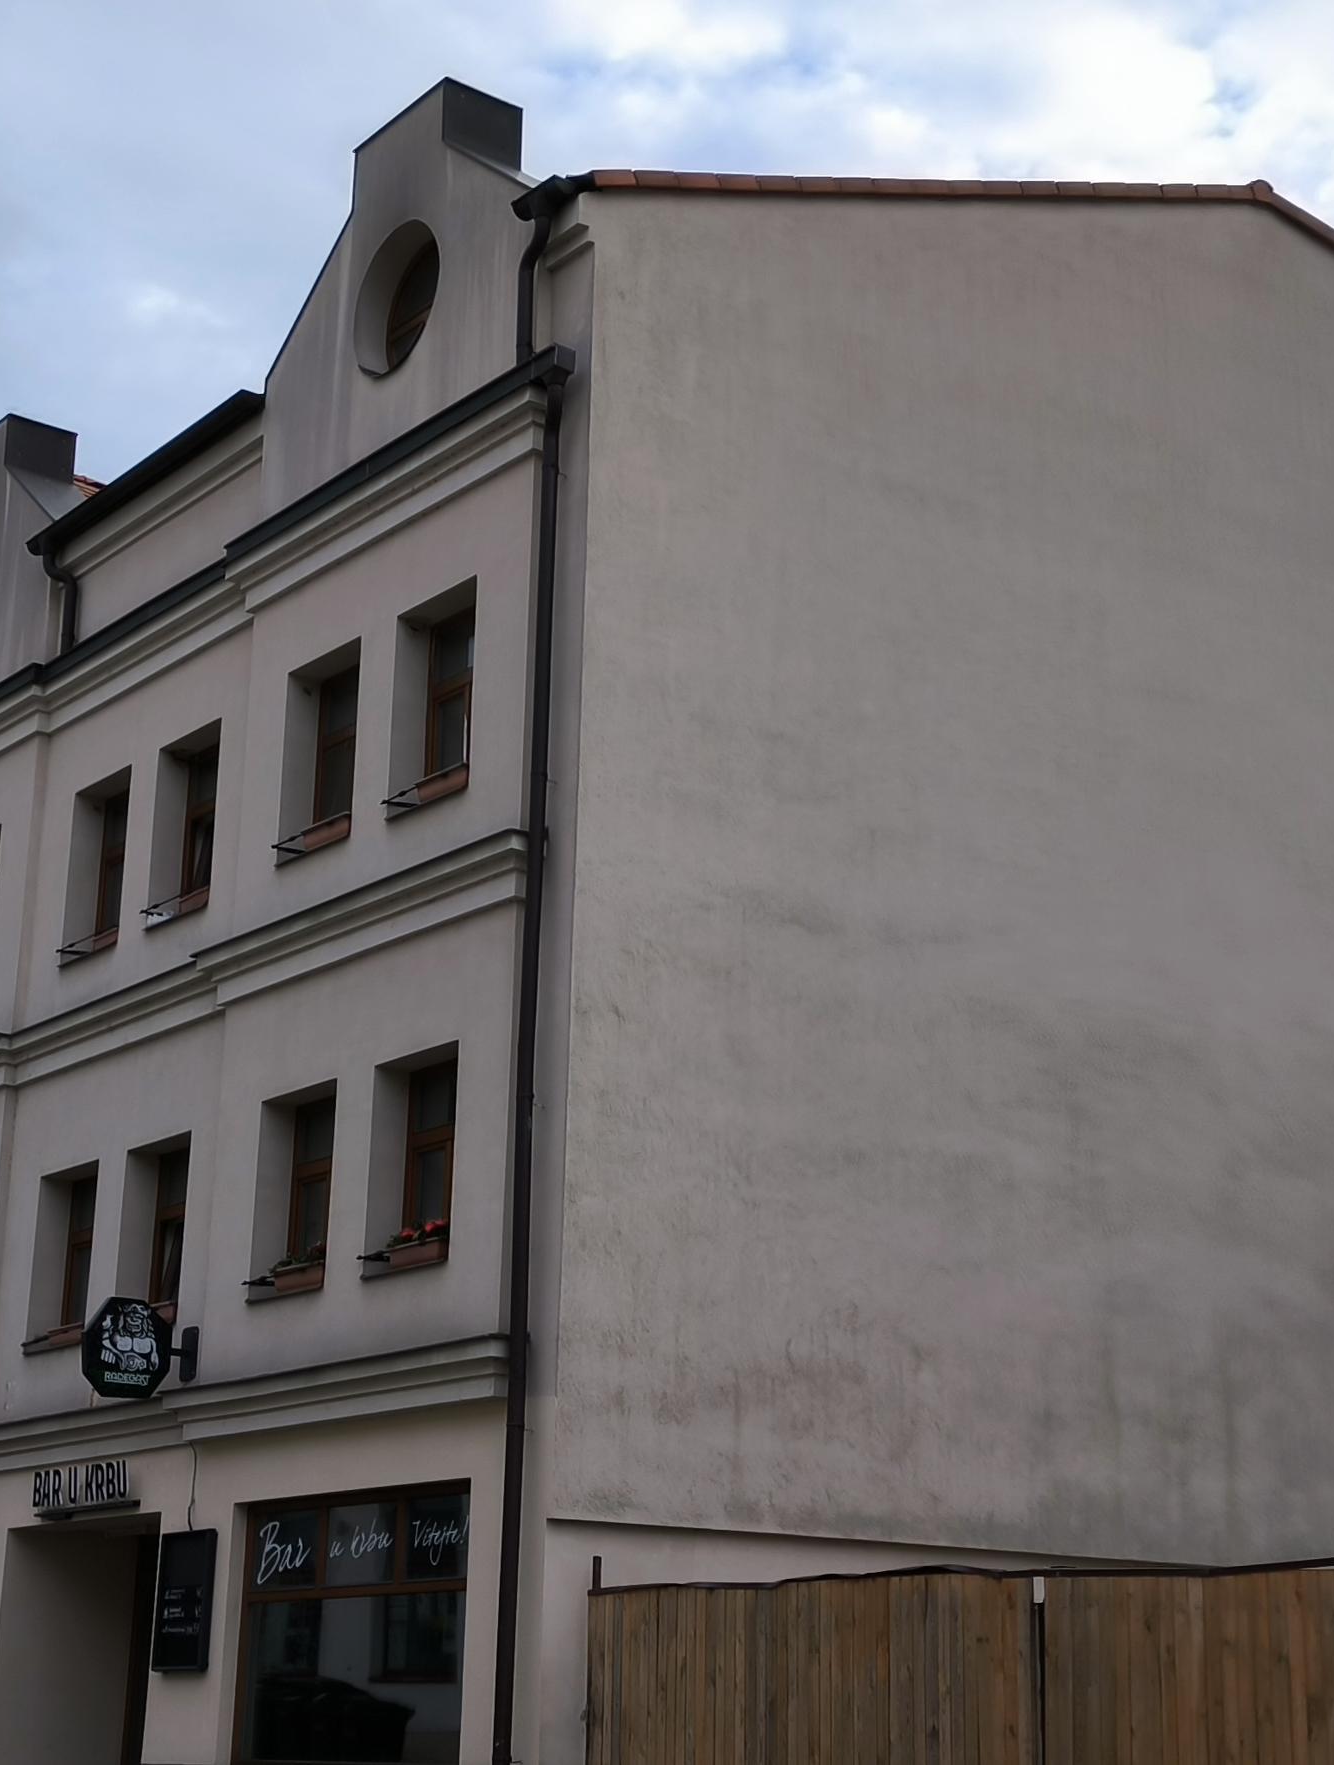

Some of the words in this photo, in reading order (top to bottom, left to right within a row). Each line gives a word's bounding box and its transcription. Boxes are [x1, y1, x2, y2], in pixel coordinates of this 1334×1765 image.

[104, 1371, 151, 1387] RADEGAST
[32, 1468, 63, 1507] BAR
[68, 1466, 78, 1504] U
[85, 1459, 128, 1503] KRBU
[257, 1521, 311, 1584] Bar
[329, 1541, 345, 1558] u
[350, 1517, 395, 1559] krbu
